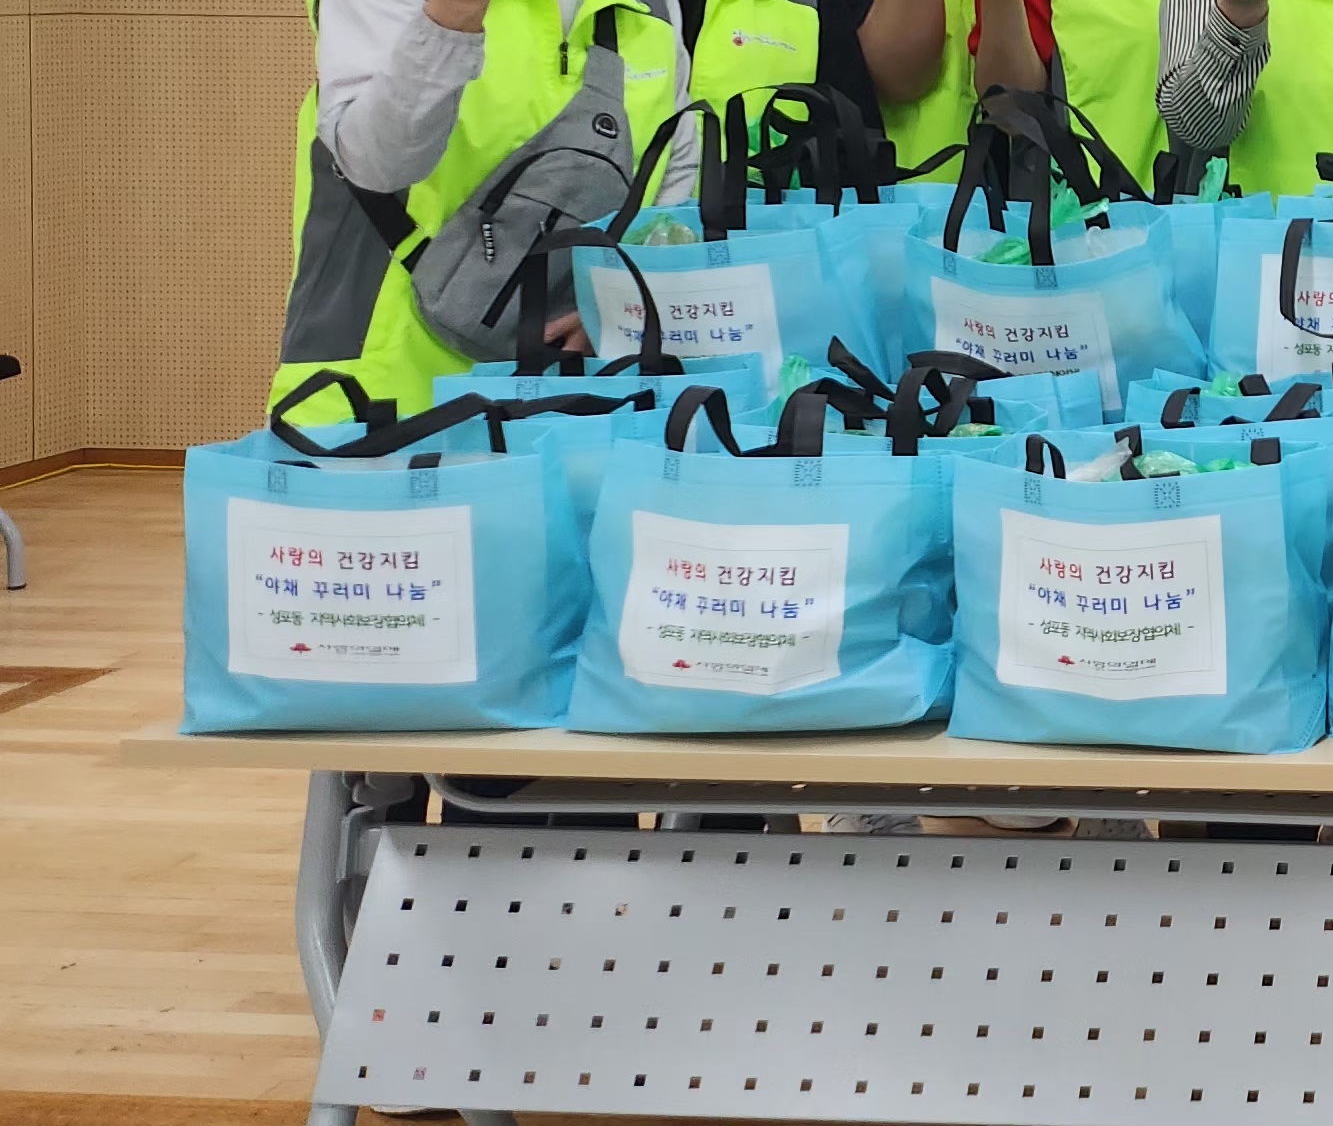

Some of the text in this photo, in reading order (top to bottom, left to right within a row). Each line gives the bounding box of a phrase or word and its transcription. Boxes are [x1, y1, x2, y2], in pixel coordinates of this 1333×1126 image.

[1005, 323, 1070, 343] 건강지킴
[993, 348, 1035, 365] 꾸러미
[269, 545, 421, 571] 사랑의 건강지킴
[716, 565, 798, 587] 건강지킴
[1039, 556, 1176, 585] 사랑의 건강지킴
[312, 580, 371, 600] 꾸러미
[1075, 593, 1128, 615] 꾸러미
